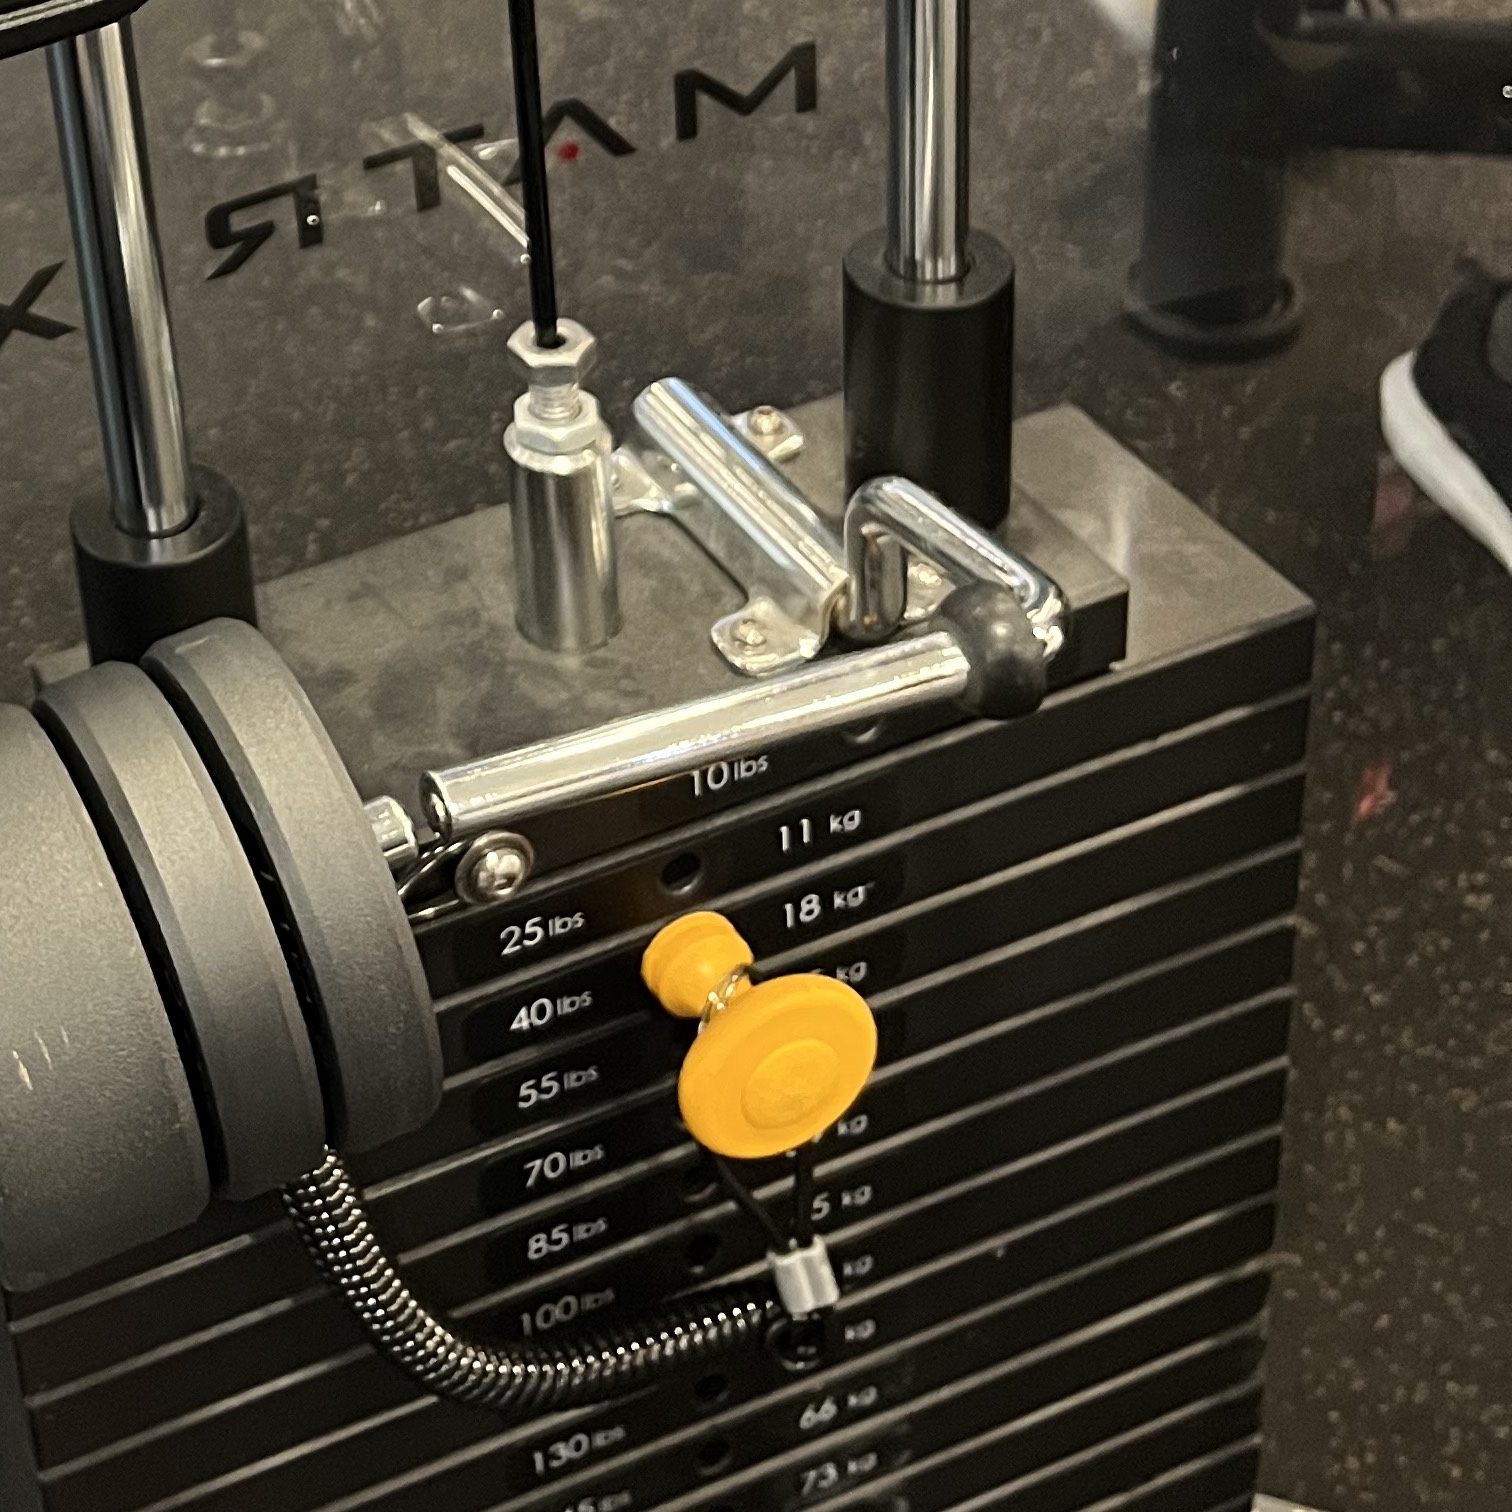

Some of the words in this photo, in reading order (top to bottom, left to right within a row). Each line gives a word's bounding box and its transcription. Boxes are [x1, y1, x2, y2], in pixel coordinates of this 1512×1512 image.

[780, 818, 811, 852] 11
[829, 810, 861, 834] kg
[784, 893, 820, 928] 18
[833, 885, 867, 910] kg
[799, 1395, 839, 1431] 66
[800, 1461, 838, 1496] 73
